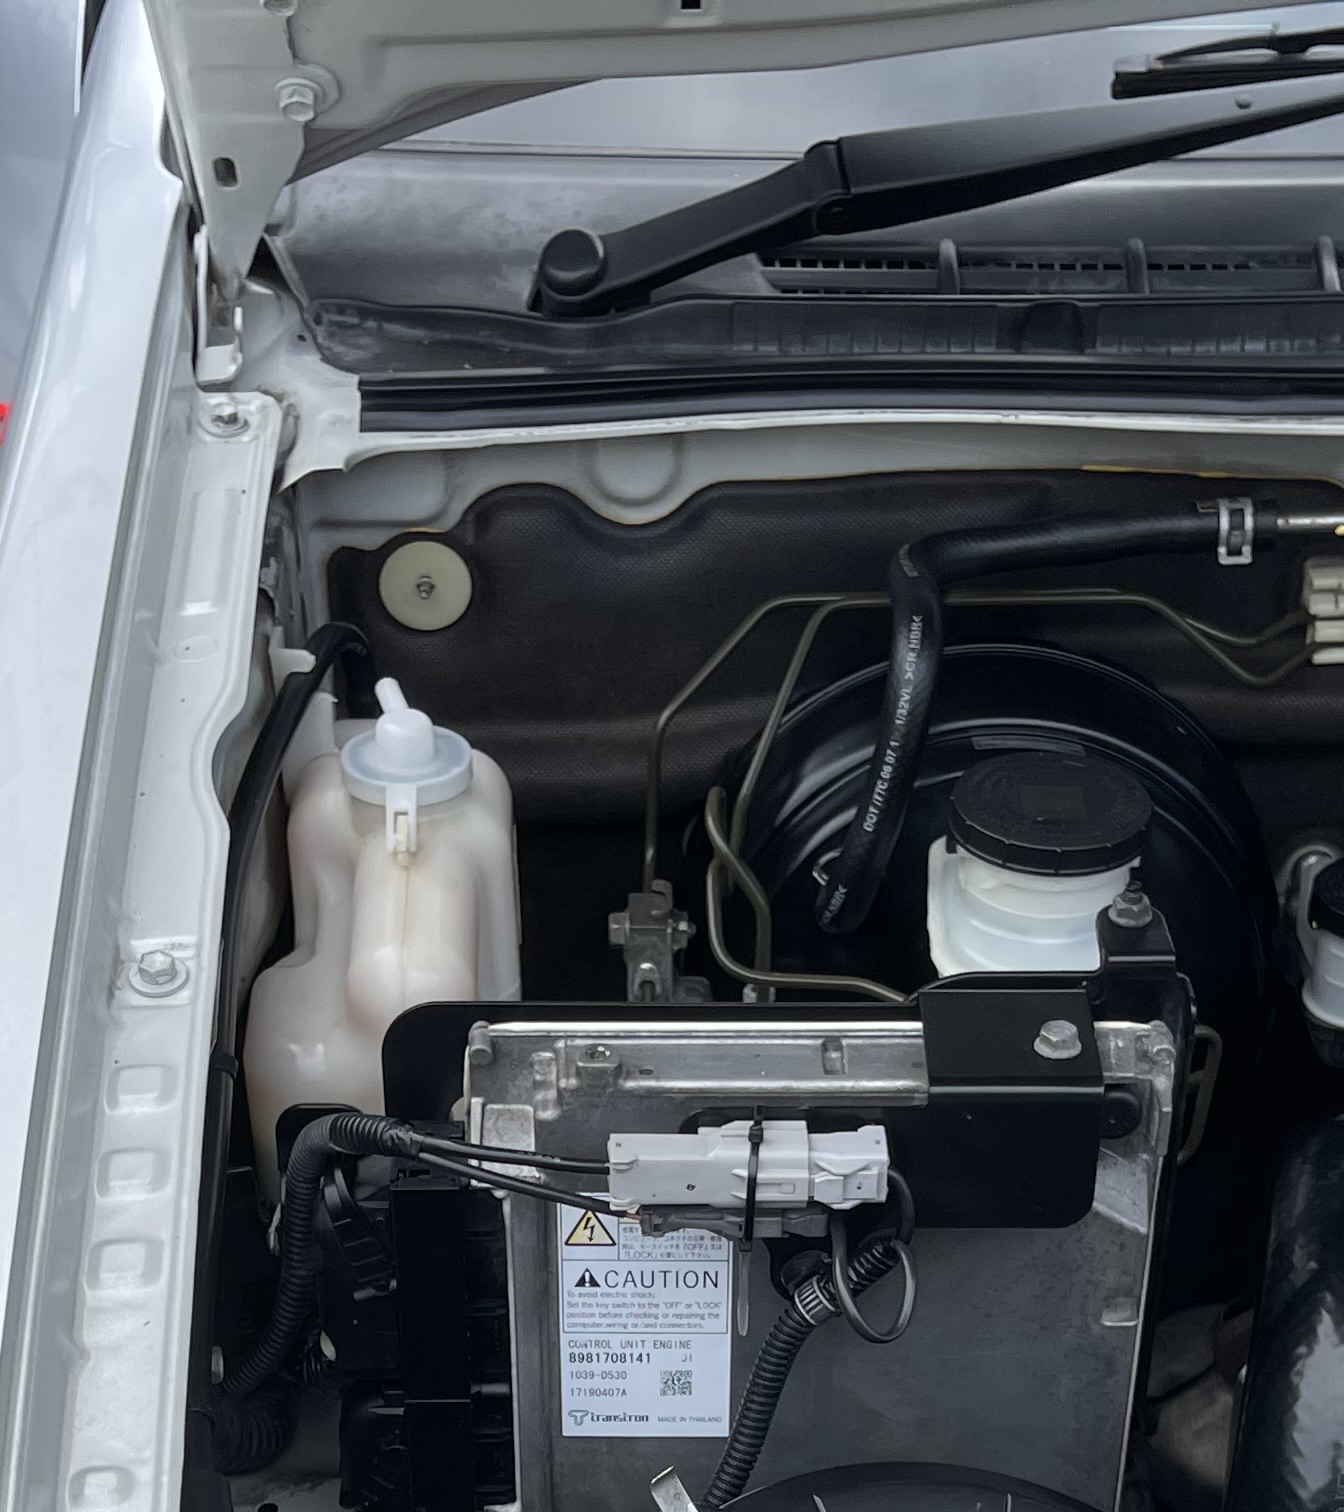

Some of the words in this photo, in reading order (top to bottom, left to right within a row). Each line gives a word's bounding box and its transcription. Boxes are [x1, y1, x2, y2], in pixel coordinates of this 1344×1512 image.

[604, 1269, 719, 1289] CAUTION
[578, 1290, 598, 1299] avoid
[600, 1290, 628, 1299] electric
[567, 1301, 579, 1309] Set
[582, 1301, 593, 1309] the
[596, 1301, 609, 1311] key
[612, 1301, 635, 1309] switch
[638, 1301, 646, 1309] to
[648, 1301, 660, 1309] the
[567, 1311, 597, 1321] position
[598, 1311, 623, 1319] before
[625, 1311, 659, 1321] checking
[672, 1311, 705, 1321] repairing
[708, 1311, 720, 1320] the
[568, 1339, 613, 1350] CONTROL
[568, 1352, 651, 1364] 8981708141
[570, 1387, 628, 1398] 17190407A
[657, 1416, 677, 1424] MADE
[679, 1416, 687, 1424] IN
[689, 1416, 723, 1424] THAILAND
